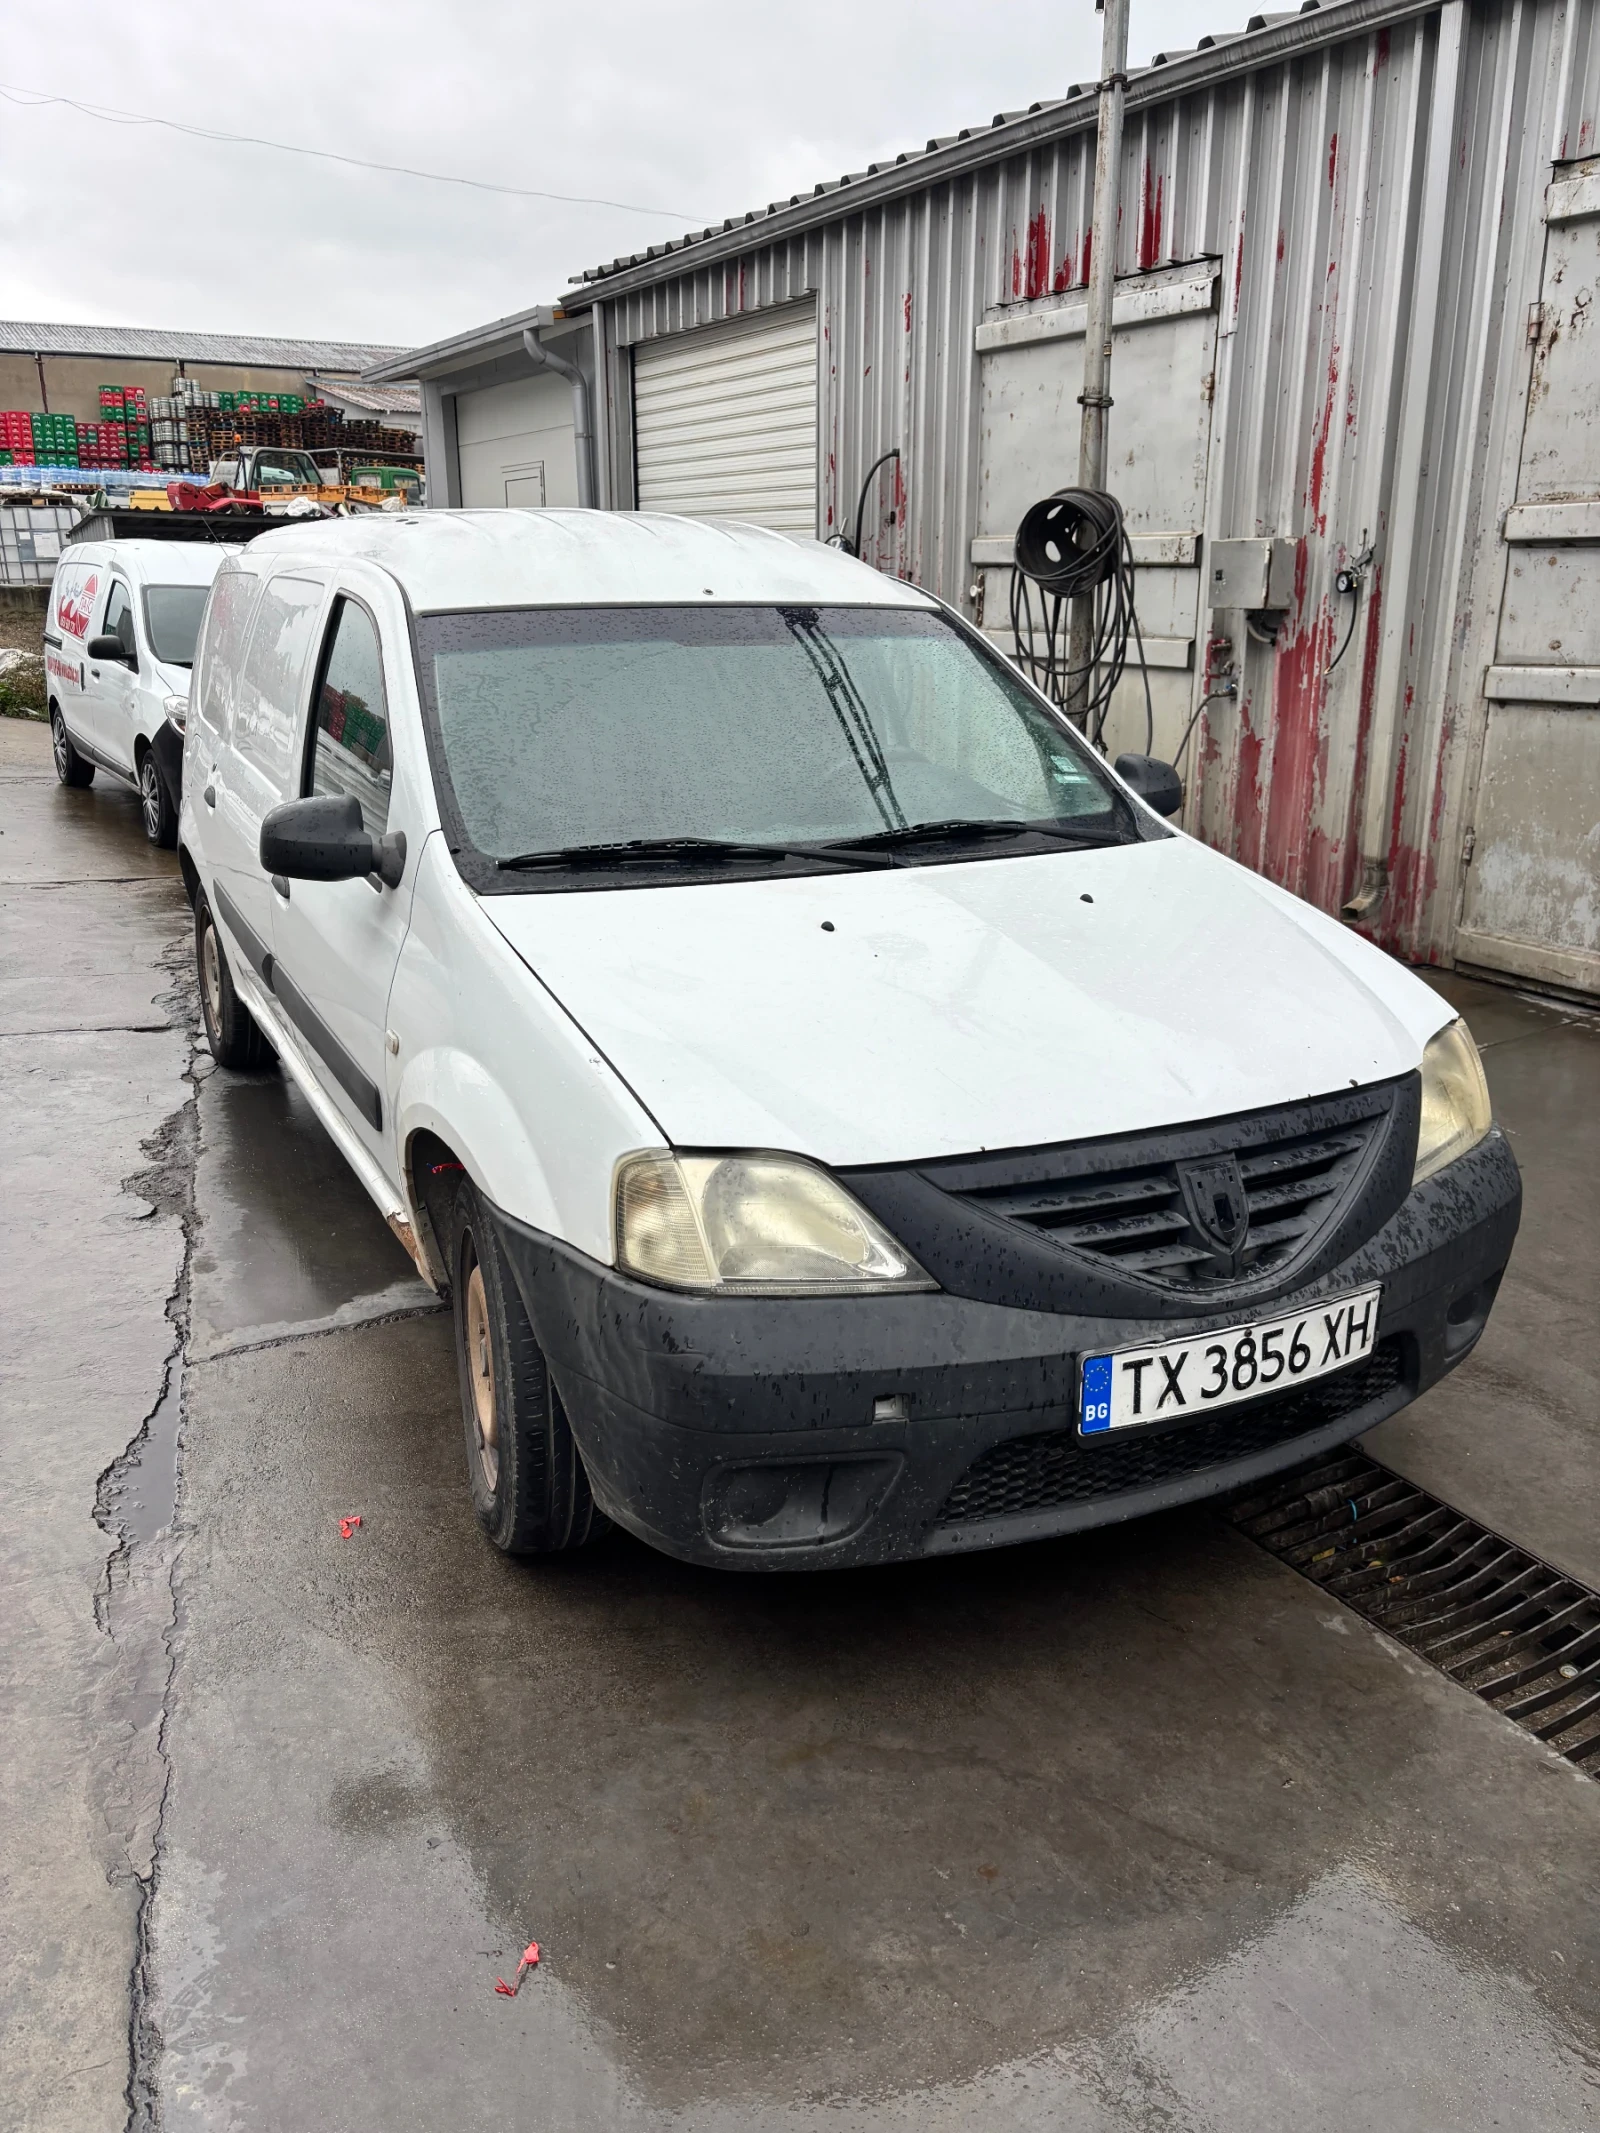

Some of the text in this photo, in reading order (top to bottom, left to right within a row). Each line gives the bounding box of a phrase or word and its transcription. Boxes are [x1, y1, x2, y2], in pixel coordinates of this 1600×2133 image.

[1122, 1300, 1371, 1415] TX 3856 XH
[1085, 1402, 1108, 1422] BG
